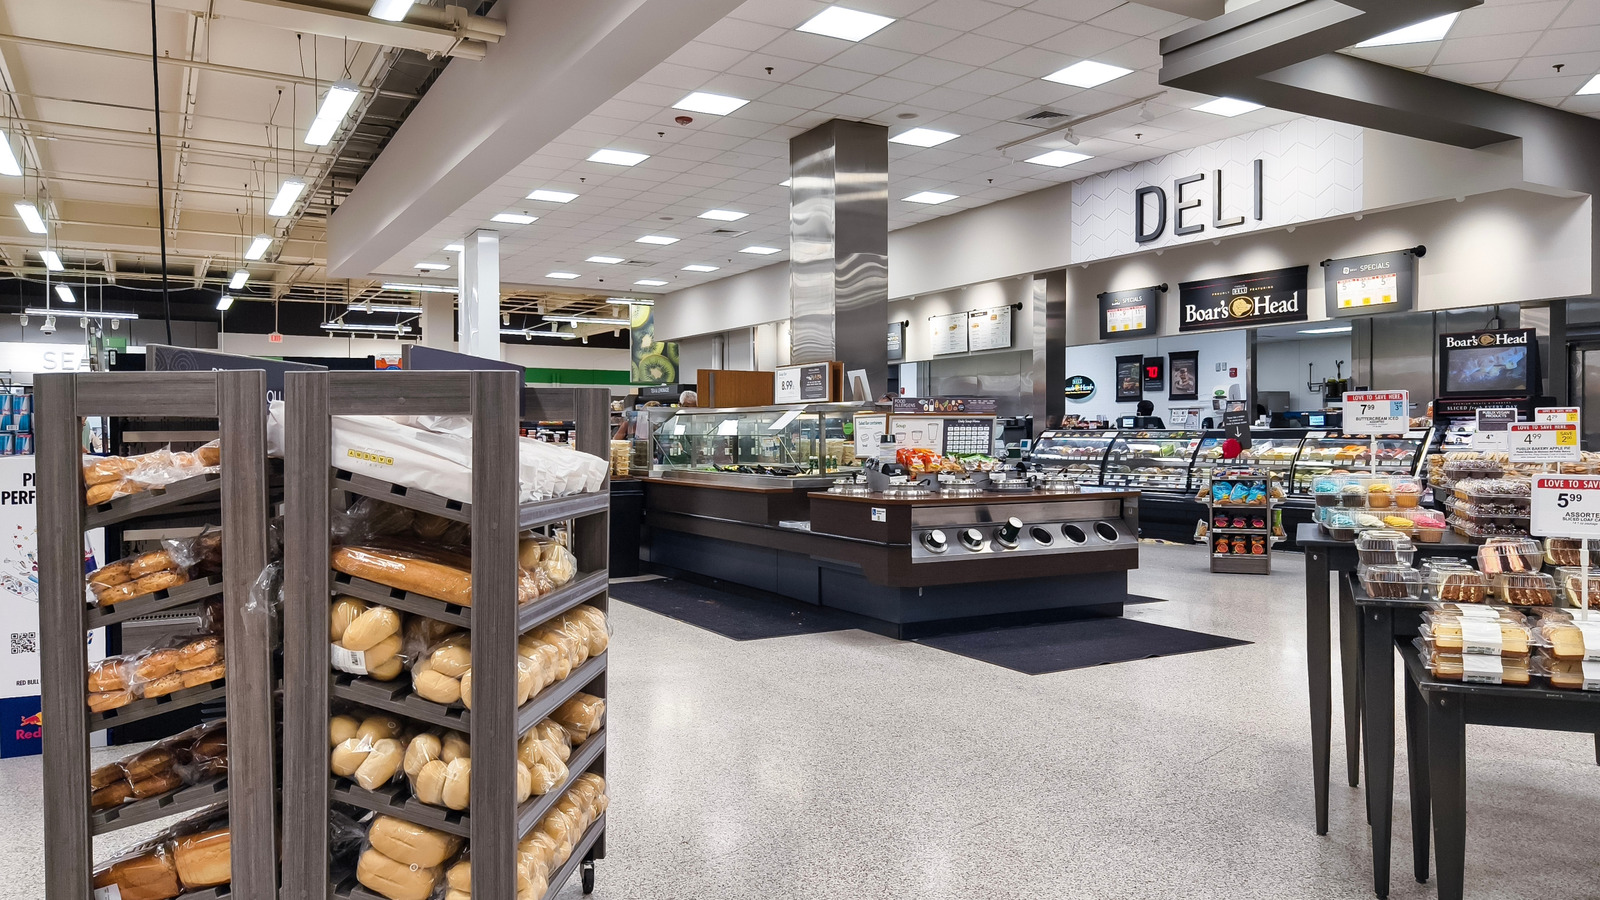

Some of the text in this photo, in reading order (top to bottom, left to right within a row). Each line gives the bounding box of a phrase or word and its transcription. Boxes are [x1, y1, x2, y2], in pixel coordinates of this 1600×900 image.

[1135, 159, 1263, 244] DELI
[1360, 262, 1390, 272] SPECIALS
[1122, 295, 1142, 303] SPECIALS
[1185, 290, 1299, 322] Boar's Head
[1446, 332, 1527, 348] Boar's Head
[781, 380, 793, 391] 8.99
[1544, 479, 1564, 488] LOVE
[1568, 480, 1579, 488] TO
[1557, 493, 1583, 508] 599
